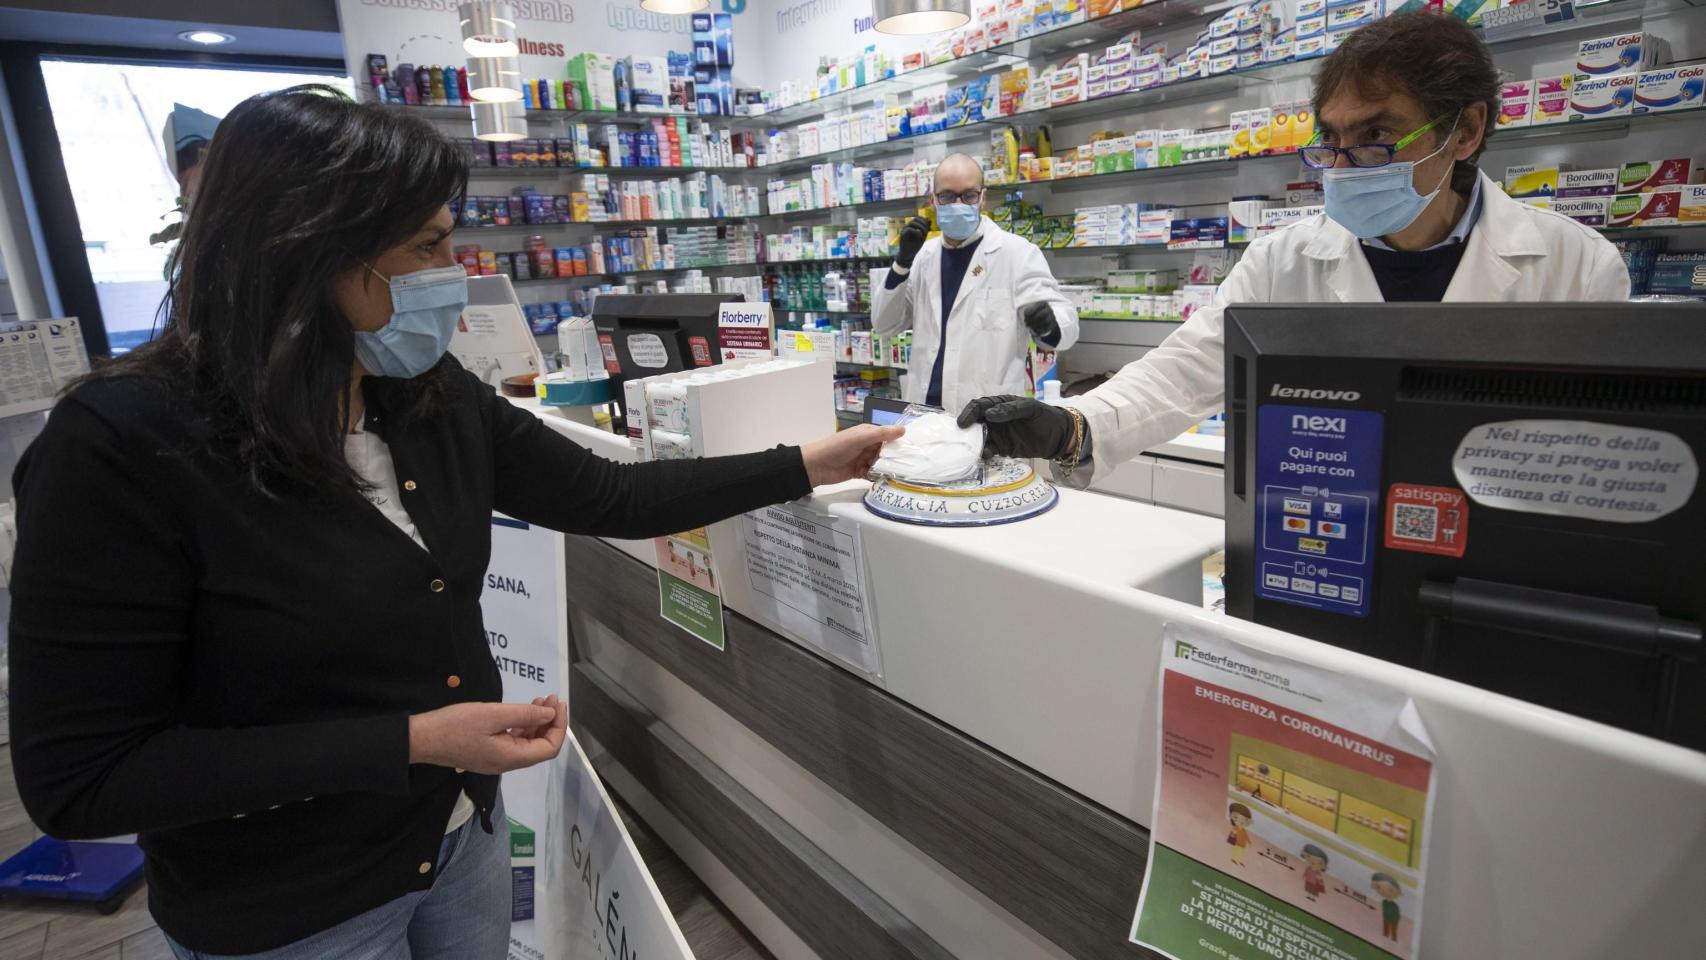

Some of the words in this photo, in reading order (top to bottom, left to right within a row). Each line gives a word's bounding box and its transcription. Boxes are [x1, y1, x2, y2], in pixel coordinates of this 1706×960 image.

[517, 37, 565, 57] llness
[1581, 39, 1615, 52] Zerinol
[1616, 35, 1640, 46] Gola
[1574, 79, 1609, 92] Zerinol
[1610, 76, 1634, 87] Gola
[1638, 71, 1677, 84] Zerinol
[1678, 68, 1704, 79] Gola
[1508, 166, 1535, 174] Bisolvon
[1566, 172, 1614, 182] Borocillina
[1265, 209, 1301, 218] ILMOTASK
[1554, 202, 1603, 212] Borocillina
[721, 311, 762, 326] Florberry
[1270, 383, 1361, 402] lenovo
[1292, 414, 1347, 433] nexi
[1485, 427, 1520, 442] Nel
[1523, 429, 1600, 448] rispetto
[1606, 435, 1661, 452] della
[1288, 446, 1313, 459] Qui
[1315, 451, 1347, 462] puoi
[1461, 446, 1535, 465] privacy
[1536, 451, 1553, 464] si
[1556, 453, 1620, 471] prega
[1626, 459, 1684, 474] voler
[1280, 461, 1327, 474] pagare
[1329, 467, 1355, 478] con
[1470, 464, 1574, 485] mantenere
[1577, 473, 1597, 487] la
[1602, 475, 1668, 493] giusta
[873, 486, 949, 513] FARMACIA
[967, 482, 1051, 513] CUZZOCREA
[1288, 502, 1308, 511] VISA
[1395, 488, 1462, 506] satispay
[1470, 483, 1545, 501] distanza
[1550, 490, 1570, 504] di
[1574, 493, 1662, 513] cortesia.
[754, 529, 776, 544] RISPETTO
[776, 538, 791, 549] DELLA
[791, 544, 816, 560] DISTANZA
[817, 554, 840, 570] MINIMA
[487, 573, 531, 600] SANA,
[495, 655, 545, 683] ATTERE
[1194, 686, 1278, 722] EMERGENZA
[1281, 714, 1396, 767] CORONAVIRUS
[1200, 890, 1213, 903] SI
[1214, 897, 1252, 922] PREGA
[1254, 916, 1269, 930] DI
[1181, 903, 1194, 917] DI
[1197, 911, 1203, 921] 1
[1206, 916, 1245, 941] METRO
[1247, 935, 1284, 959] L'UNO
[1191, 897, 1205, 911] LA
[1207, 904, 1264, 939] DISTANZA
[1266, 933, 1281, 948] DI
[1199, 938, 1228, 957] Grazie
